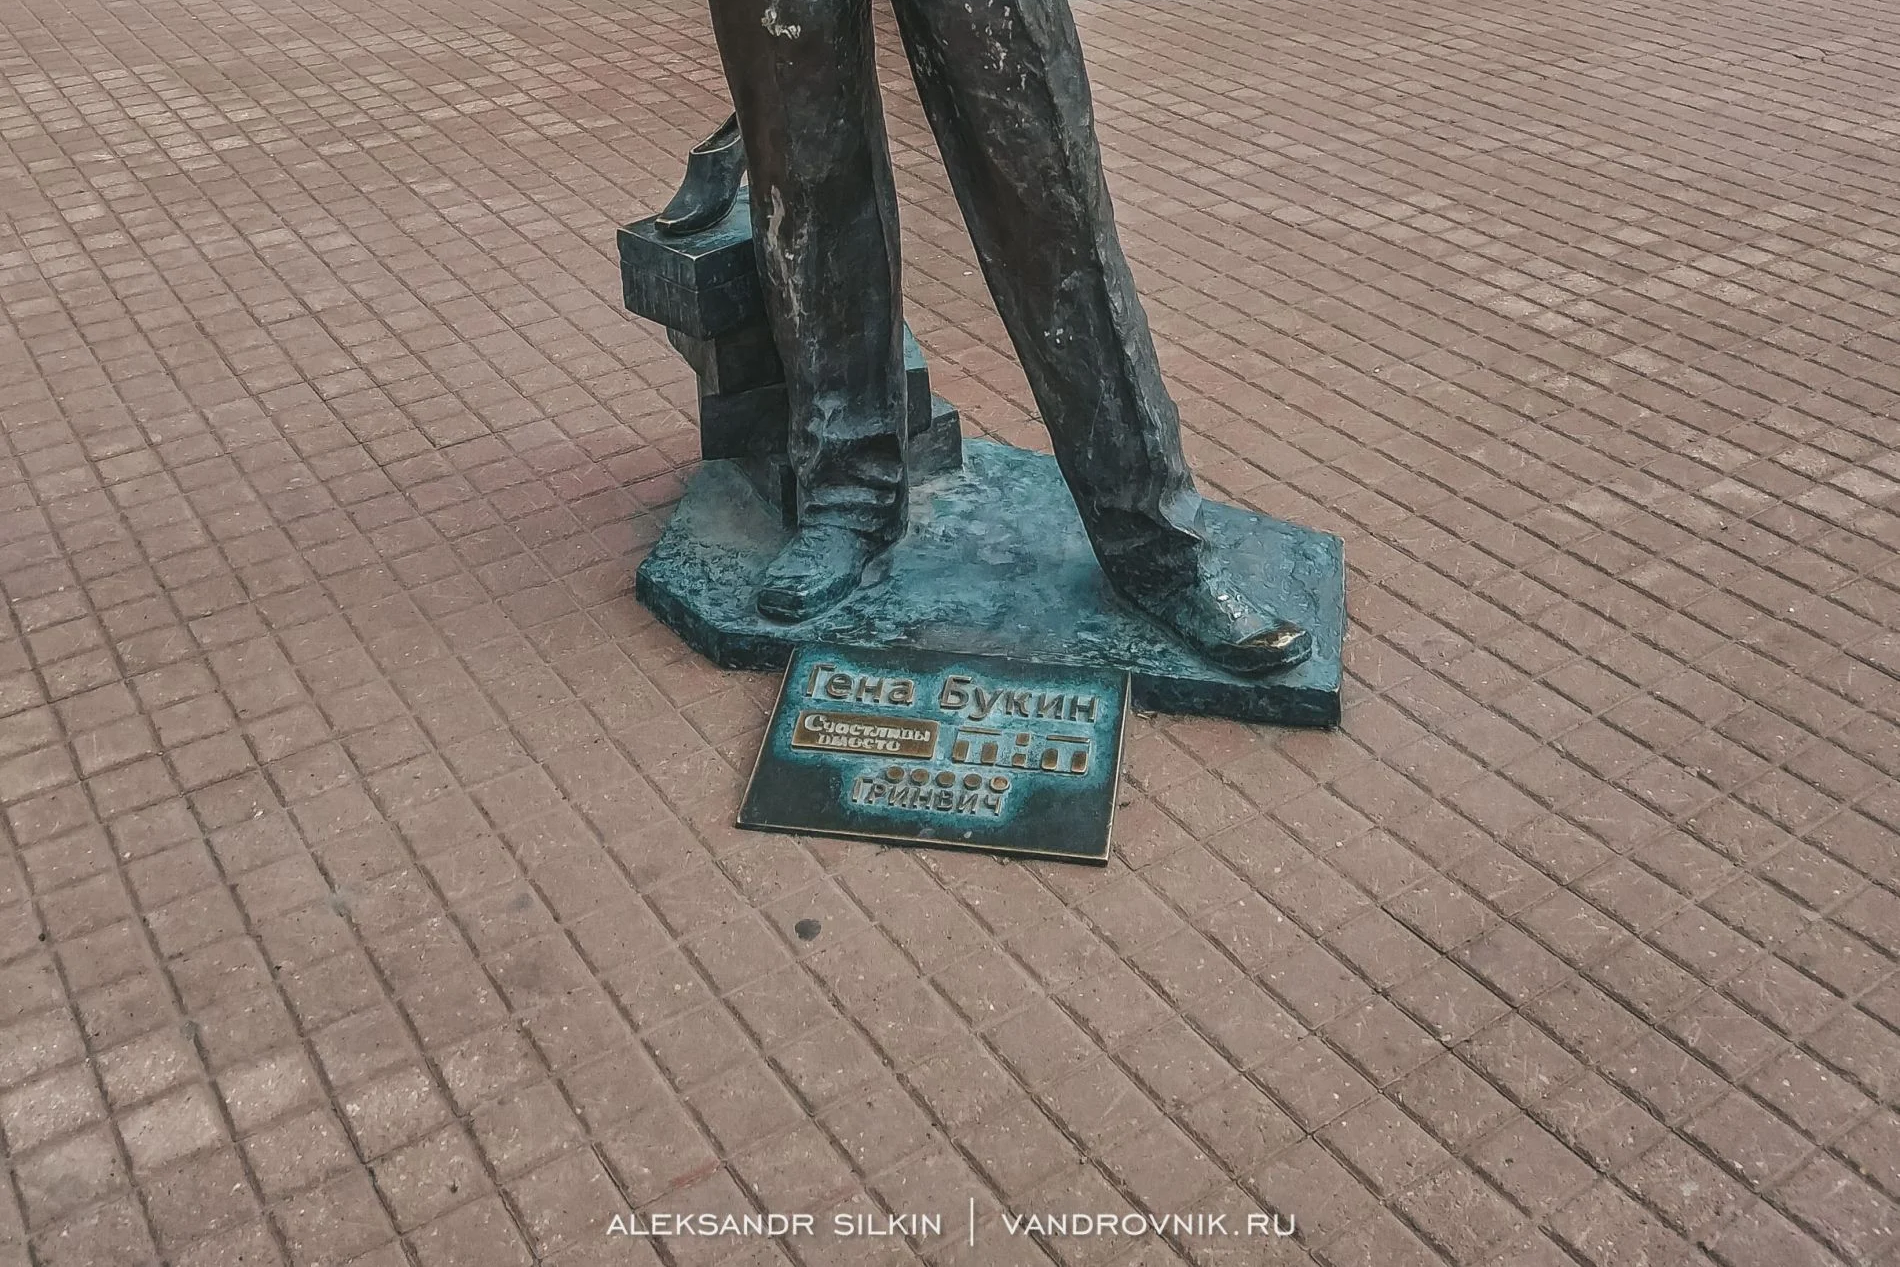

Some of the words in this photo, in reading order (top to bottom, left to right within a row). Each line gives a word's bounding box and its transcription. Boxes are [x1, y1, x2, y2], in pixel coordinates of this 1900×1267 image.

[806, 663, 915, 706] Гена
[940, 674, 1099, 721] Букин
[804, 714, 930, 741] Счастливы
